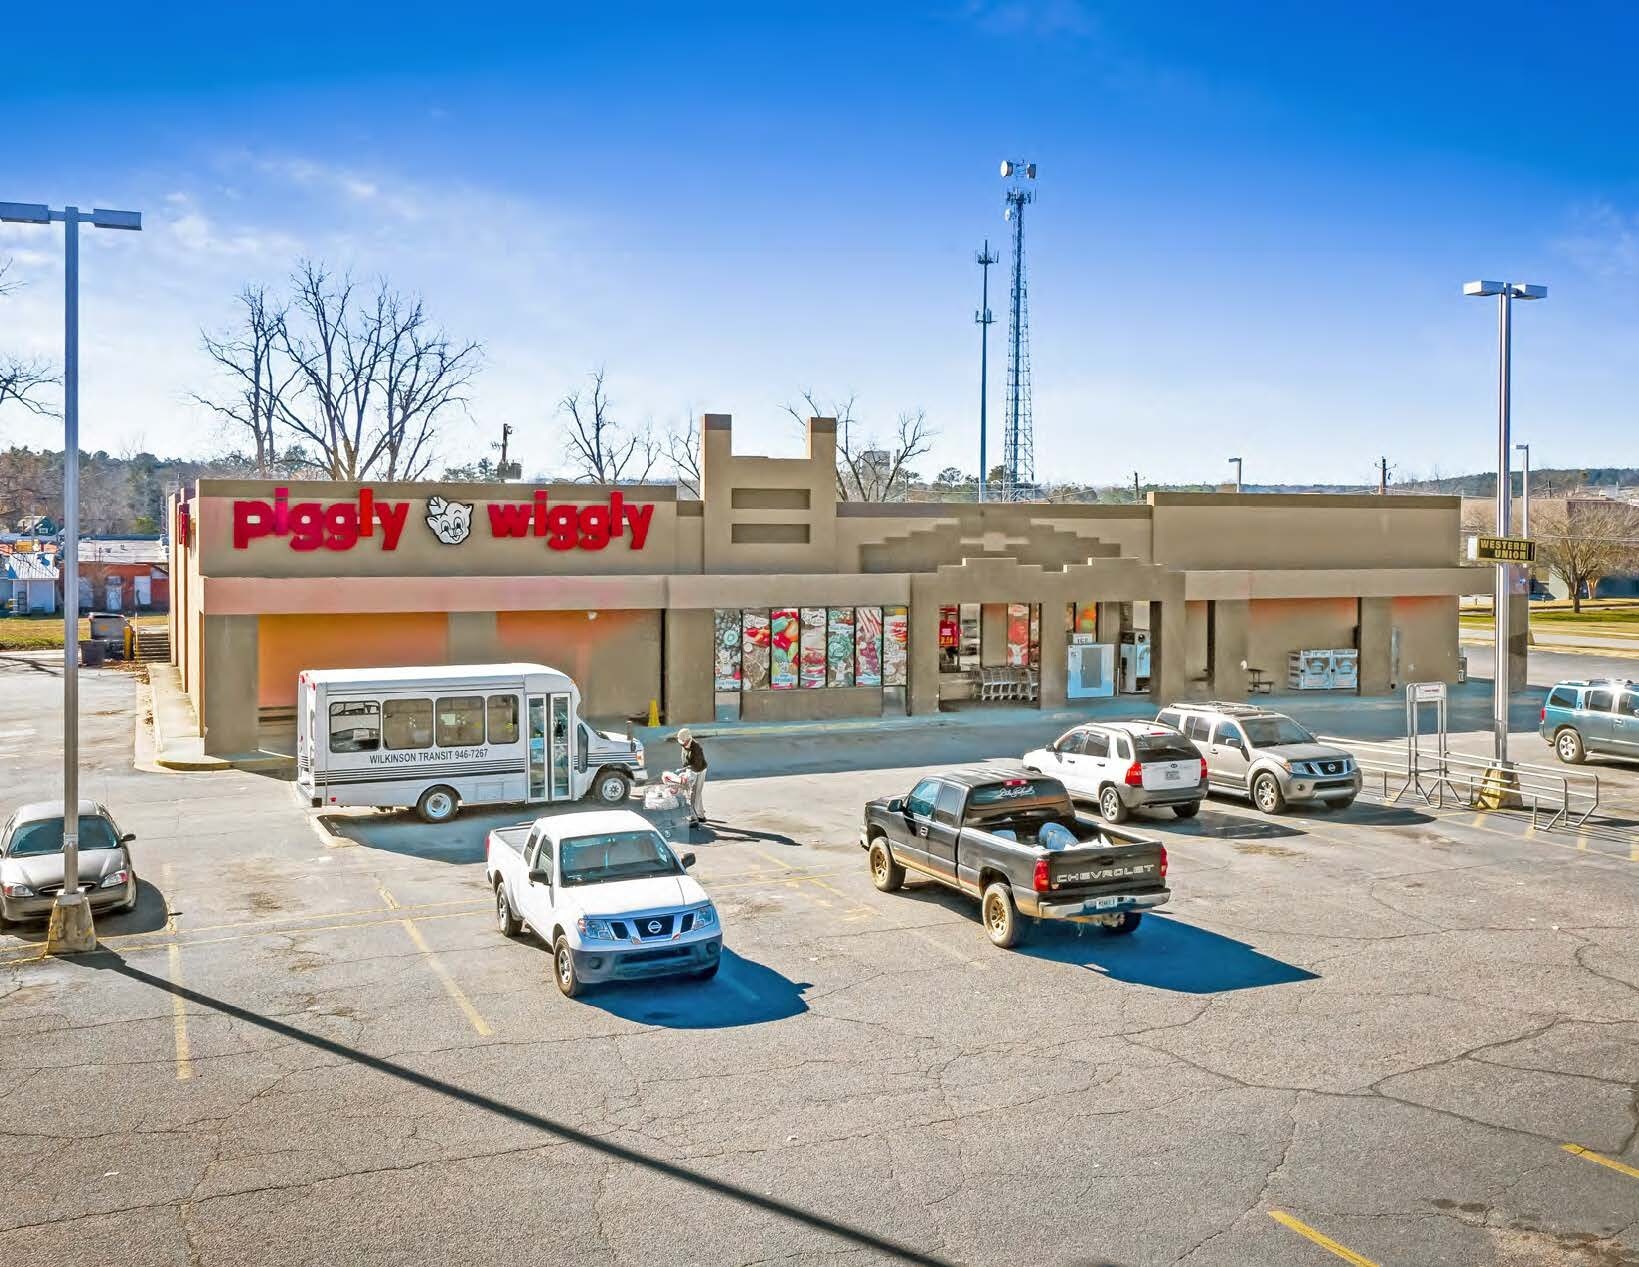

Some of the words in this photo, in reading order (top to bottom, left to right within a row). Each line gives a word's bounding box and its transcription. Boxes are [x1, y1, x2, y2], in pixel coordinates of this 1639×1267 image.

[233, 487, 410, 551] piggly
[487, 489, 655, 551] wiggly
[1480, 539, 1526, 551] WESTERN
[1494, 549, 1526, 560] UNION
[369, 753, 417, 764] WILKINSON
[418, 751, 453, 762] TRANSIT
[454, 748, 488, 760] 946-7267
[1056, 864, 1155, 883] CHEVROLET
